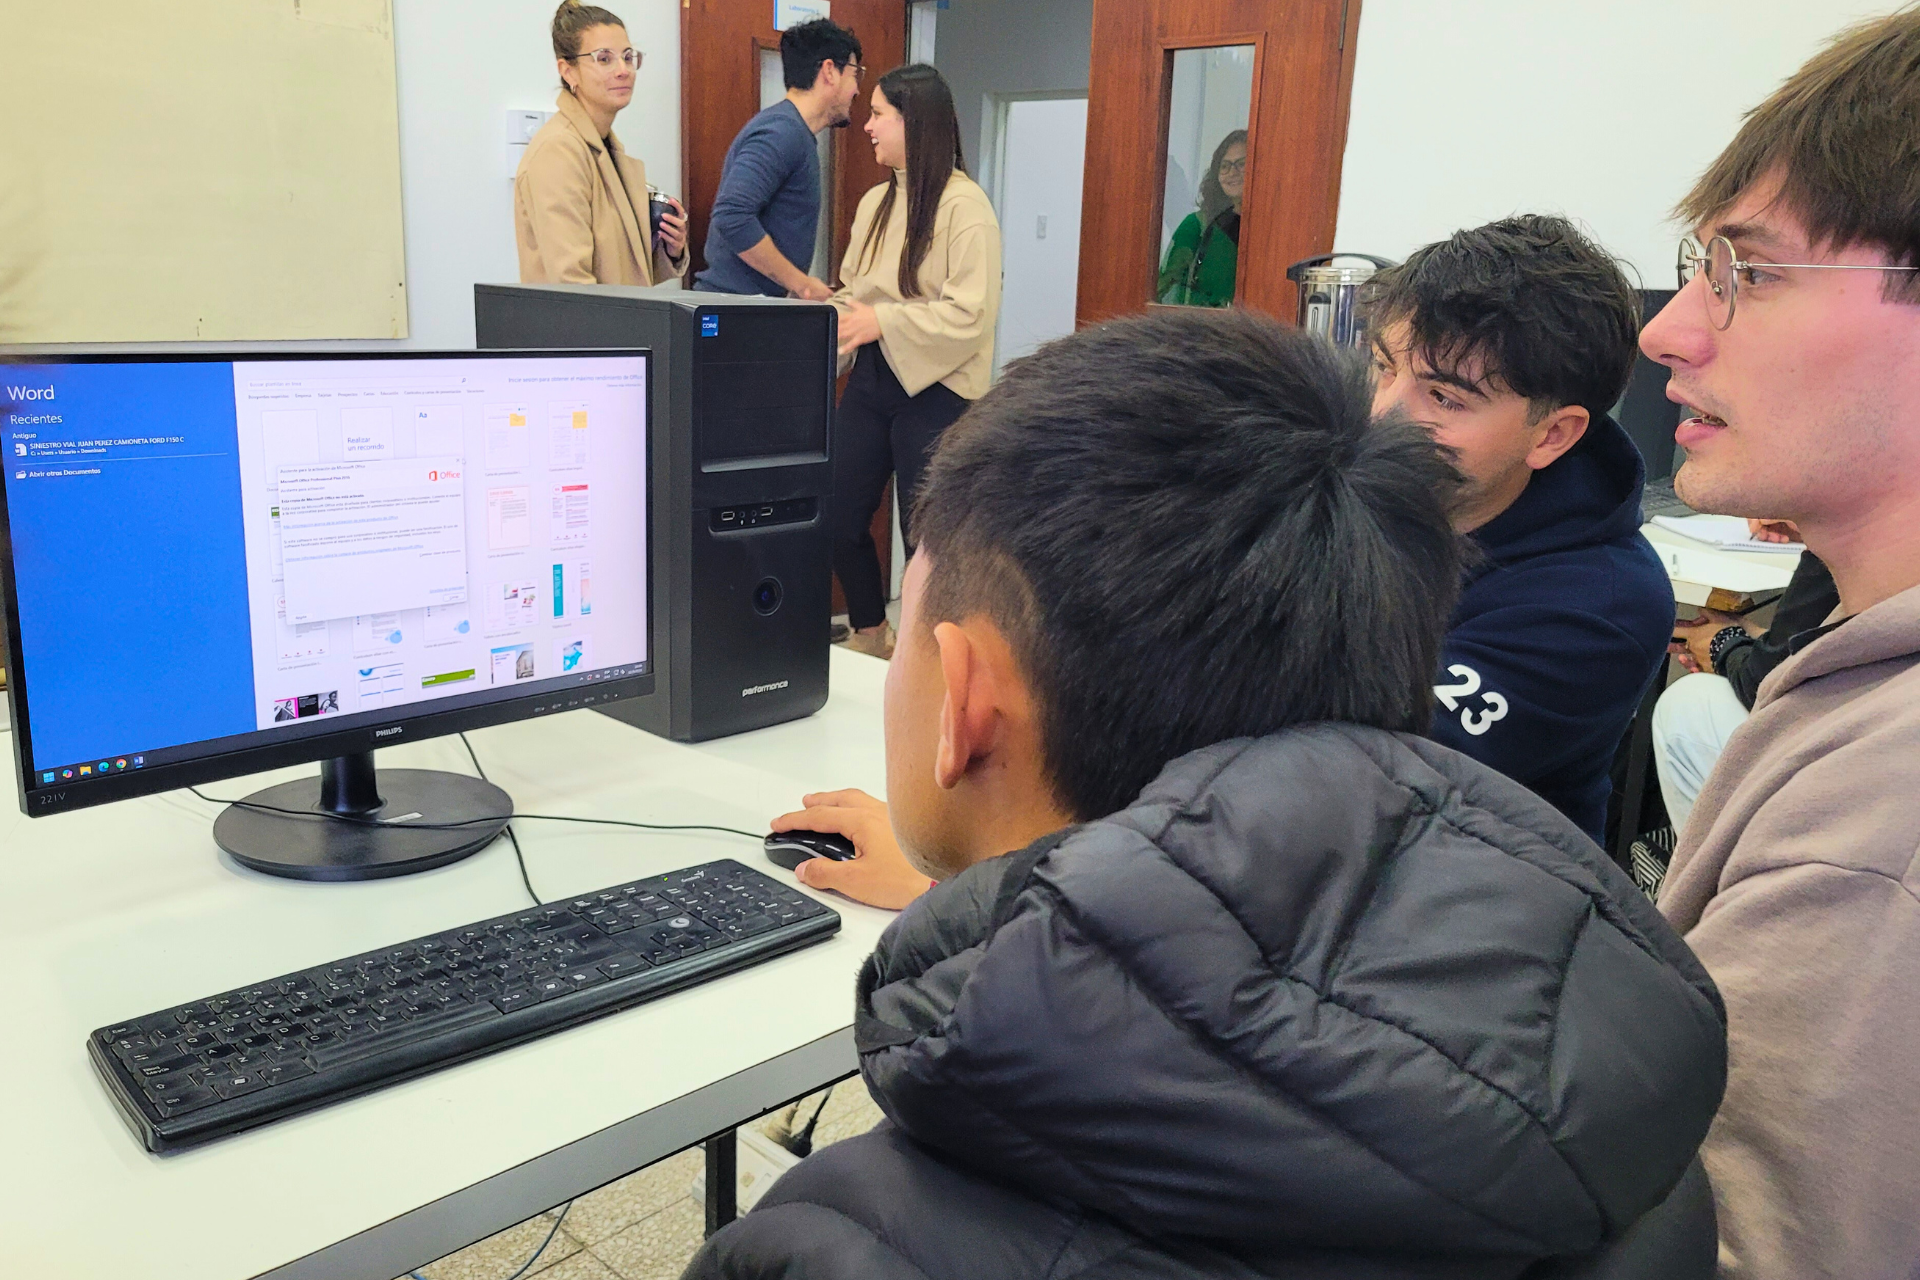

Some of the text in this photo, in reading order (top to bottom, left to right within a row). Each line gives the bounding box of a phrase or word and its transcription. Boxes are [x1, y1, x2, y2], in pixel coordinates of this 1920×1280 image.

[7, 385, 55, 401] Word
[10, 414, 63, 425] Recientes
[12, 432, 37, 440] Antiguo
[347, 436, 371, 444] Realizar
[29, 442, 62, 450] SINIESTRO
[94, 439, 113, 447] PEREZ
[113, 438, 149, 446] CAMIONETA
[357, 442, 385, 451] recorrido
[440, 471, 460, 479] Office
[742, 680, 789, 697] performance
[1433, 664, 1509, 736] 23
[375, 726, 403, 737] PHILIPS
[41, 792, 66, 804] 221V
